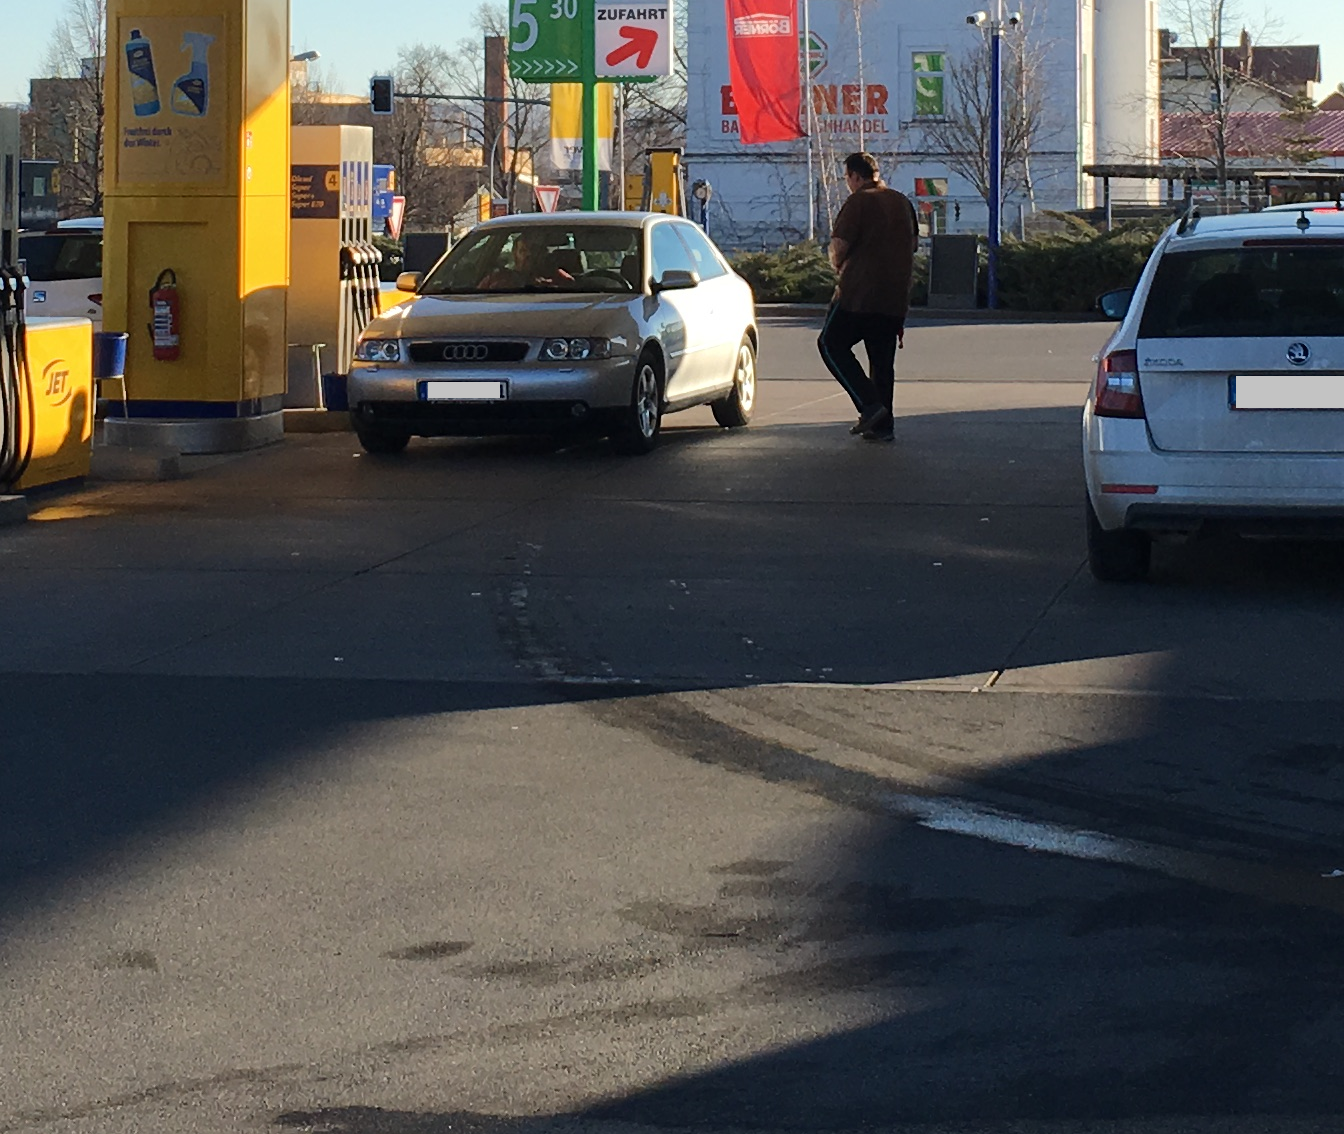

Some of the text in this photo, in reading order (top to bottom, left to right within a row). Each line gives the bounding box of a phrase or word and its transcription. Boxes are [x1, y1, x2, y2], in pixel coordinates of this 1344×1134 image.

[597, 8, 668, 21] ZUFAHRT
[720, 84, 889, 116] BNER
[329, 174, 338, 186] 4
[45, 369, 69, 396] JET
